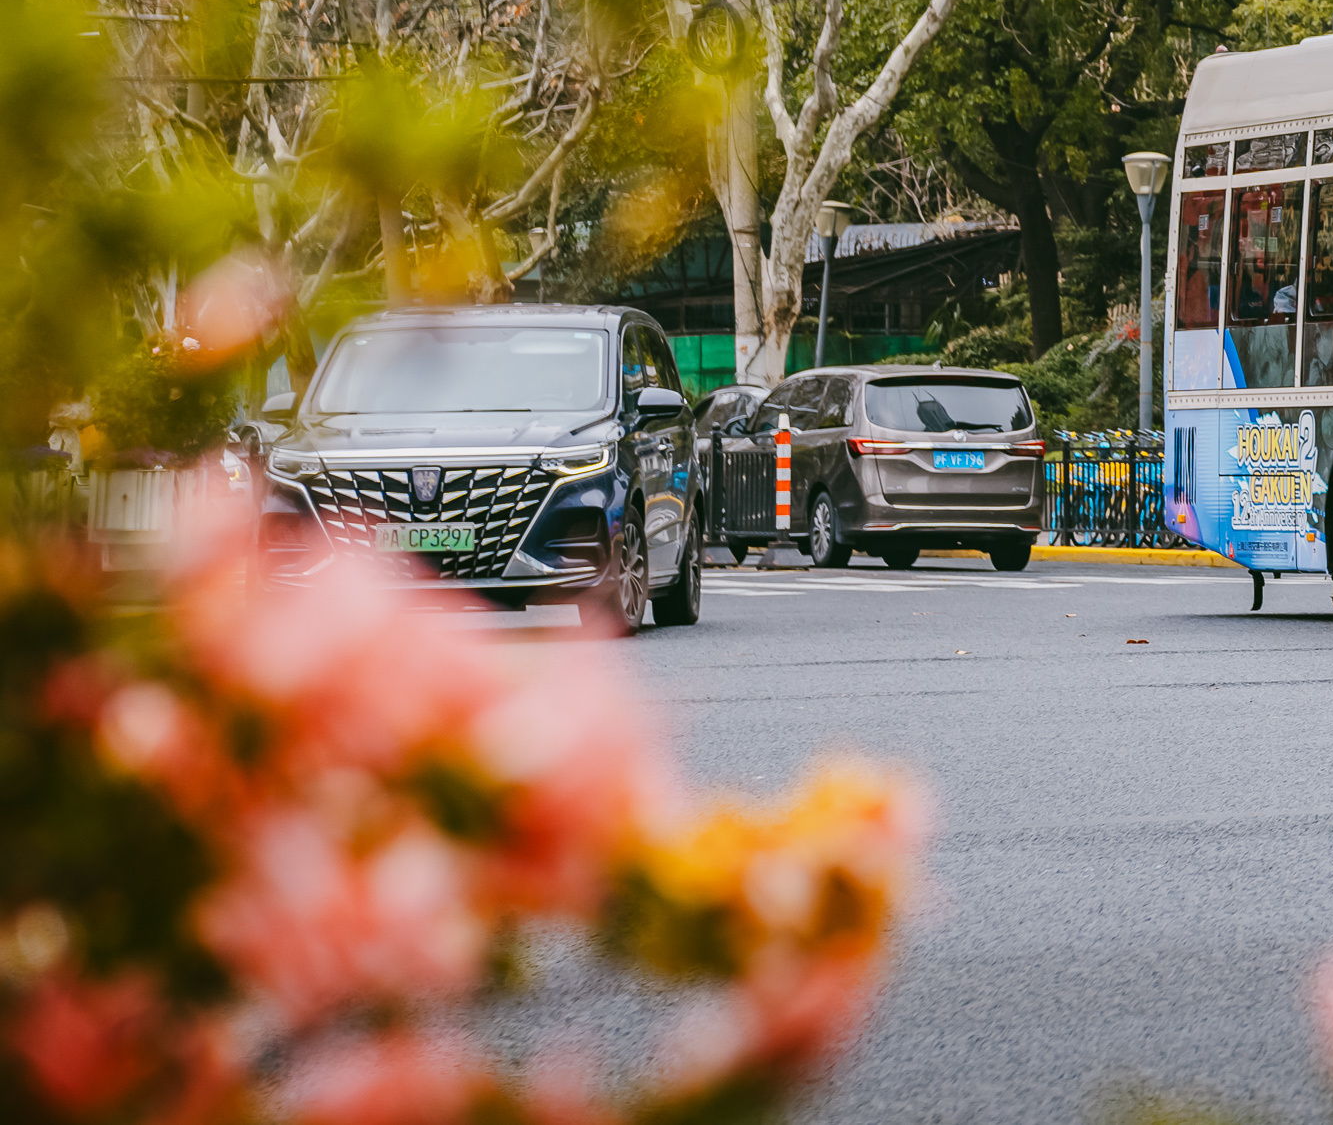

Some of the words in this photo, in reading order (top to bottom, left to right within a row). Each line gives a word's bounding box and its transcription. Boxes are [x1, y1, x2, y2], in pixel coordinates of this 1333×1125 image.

[1237, 425, 1299, 463] HOUKAI
[1299, 410, 1317, 476] 2
[1250, 469, 1313, 506] GAKUEN
[409, 528, 472, 547] CP3297
